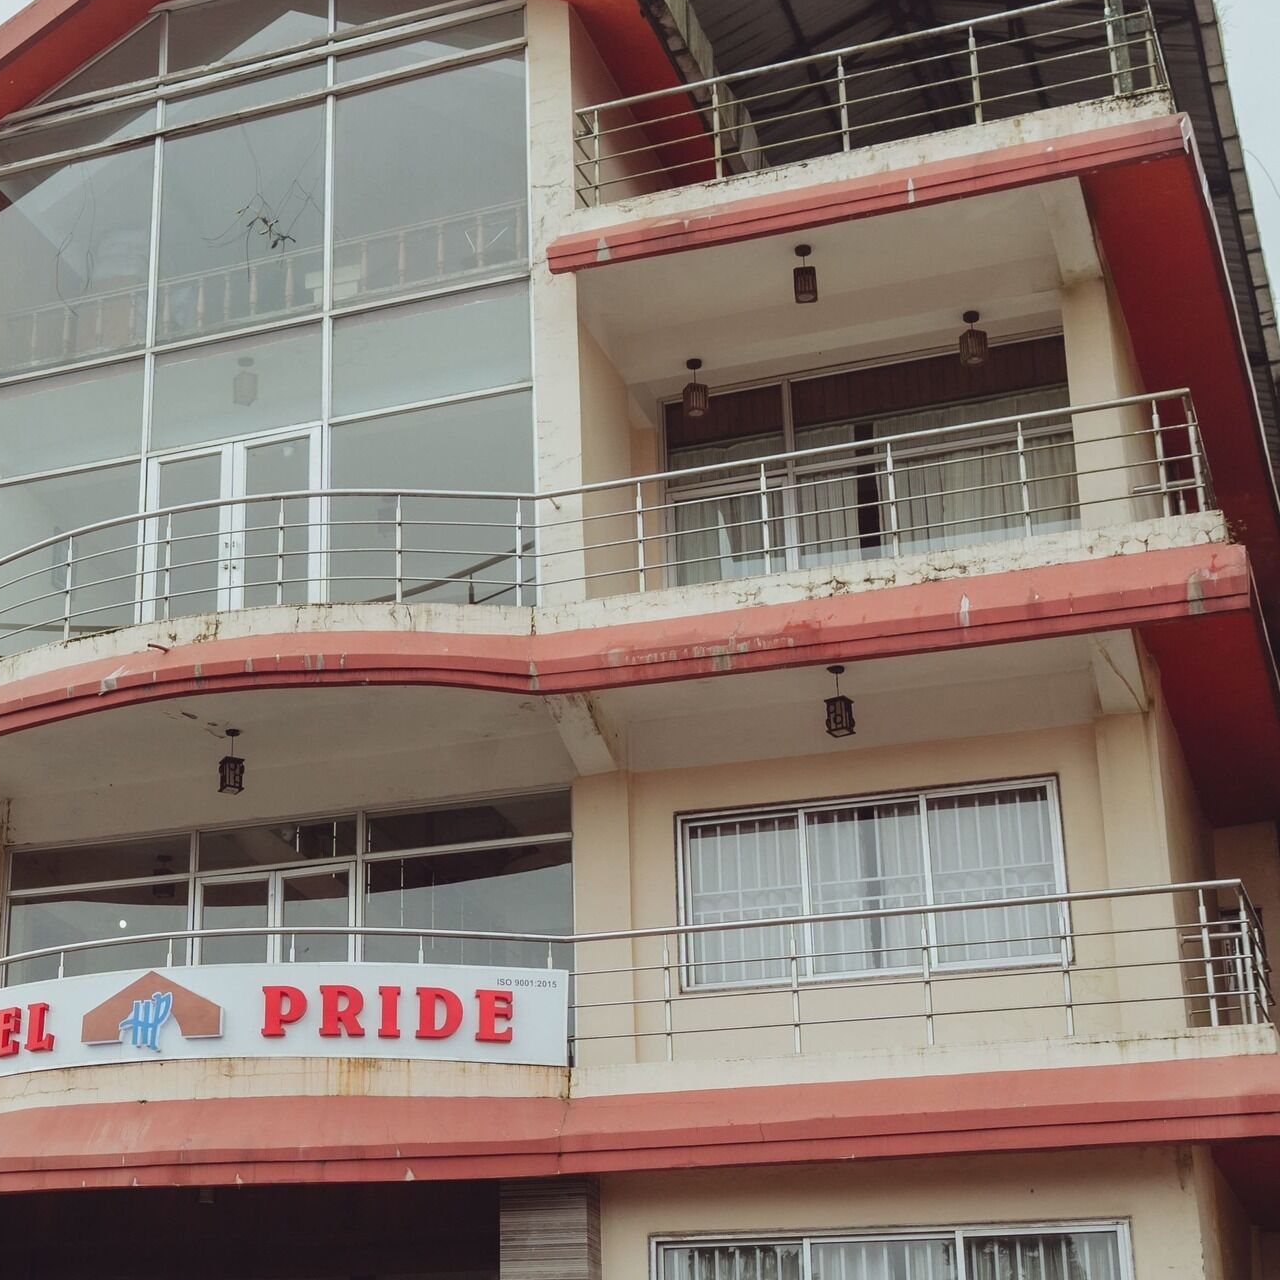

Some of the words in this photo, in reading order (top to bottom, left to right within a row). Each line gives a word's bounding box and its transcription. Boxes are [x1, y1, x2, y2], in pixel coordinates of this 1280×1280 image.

[496, 978, 513, 986] ISO
[514, 979, 557, 988] 9001:2015
[261, 985, 513, 1042] PRIDE
